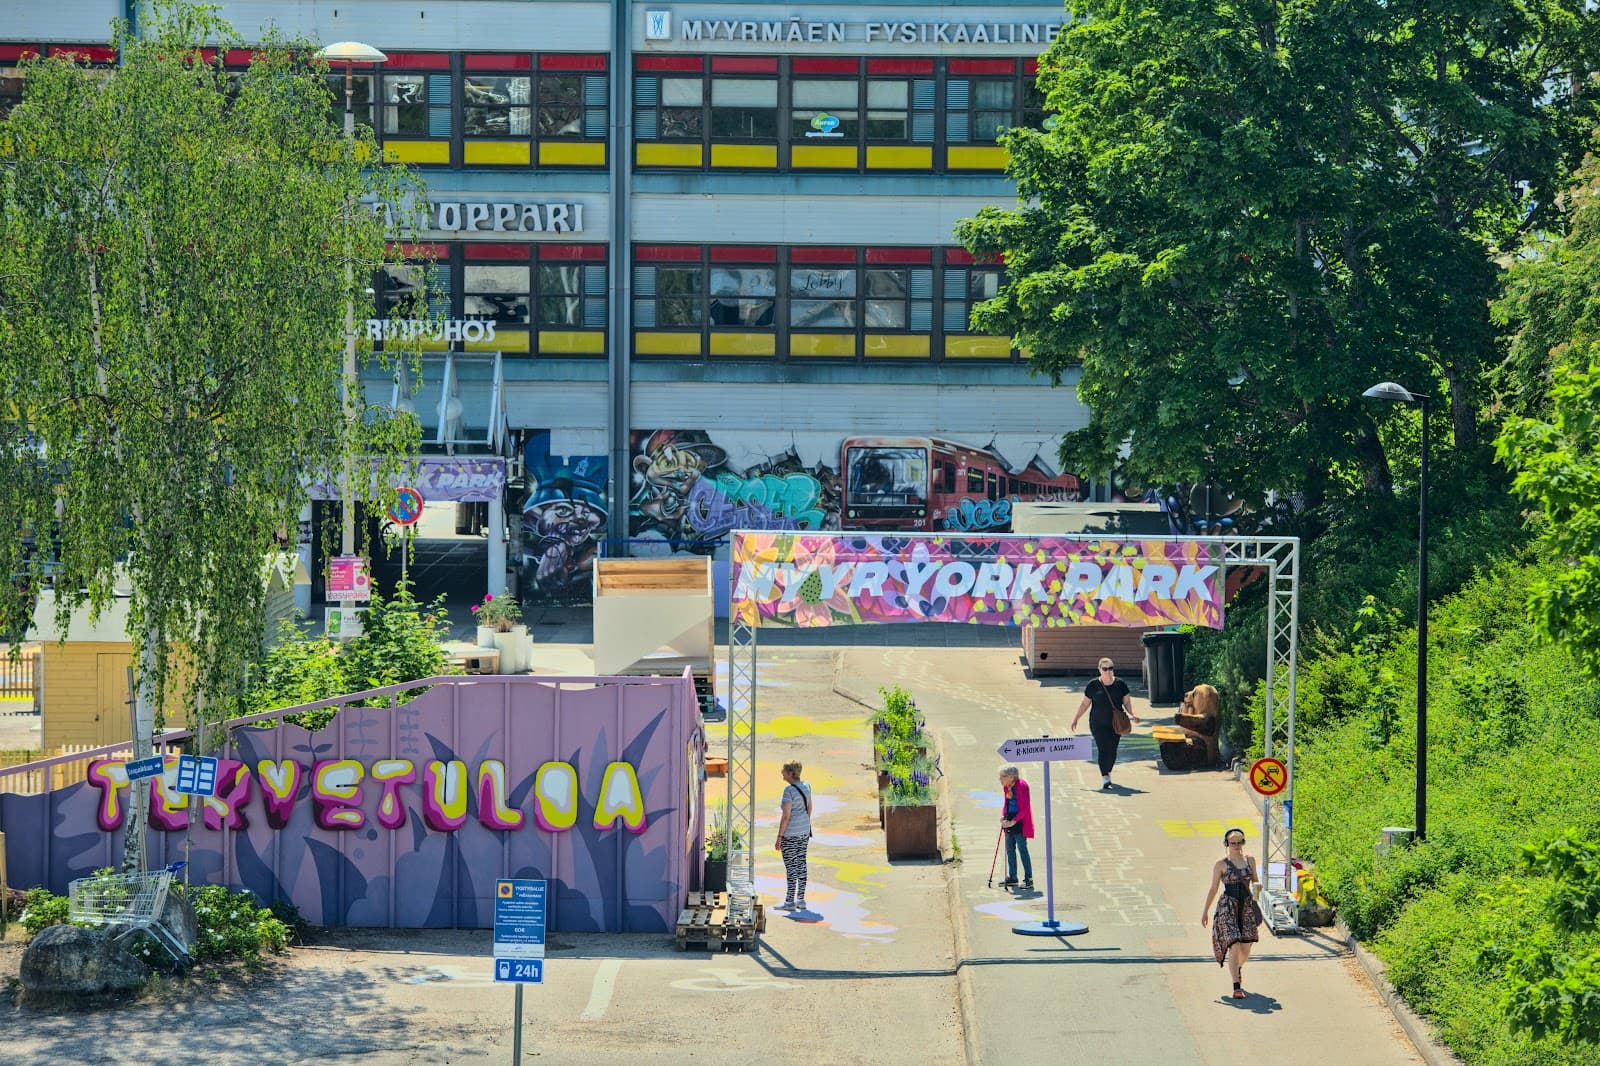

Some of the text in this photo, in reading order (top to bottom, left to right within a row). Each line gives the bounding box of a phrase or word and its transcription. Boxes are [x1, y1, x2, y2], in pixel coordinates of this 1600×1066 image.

[865, 21, 1061, 44] FYSIKAALINE
[436, 471, 503, 489] PARK
[913, 519, 926, 527] 201
[732, 561, 1220, 602] MYYR YORK PARK
[515, 964, 539, 978] 24h
